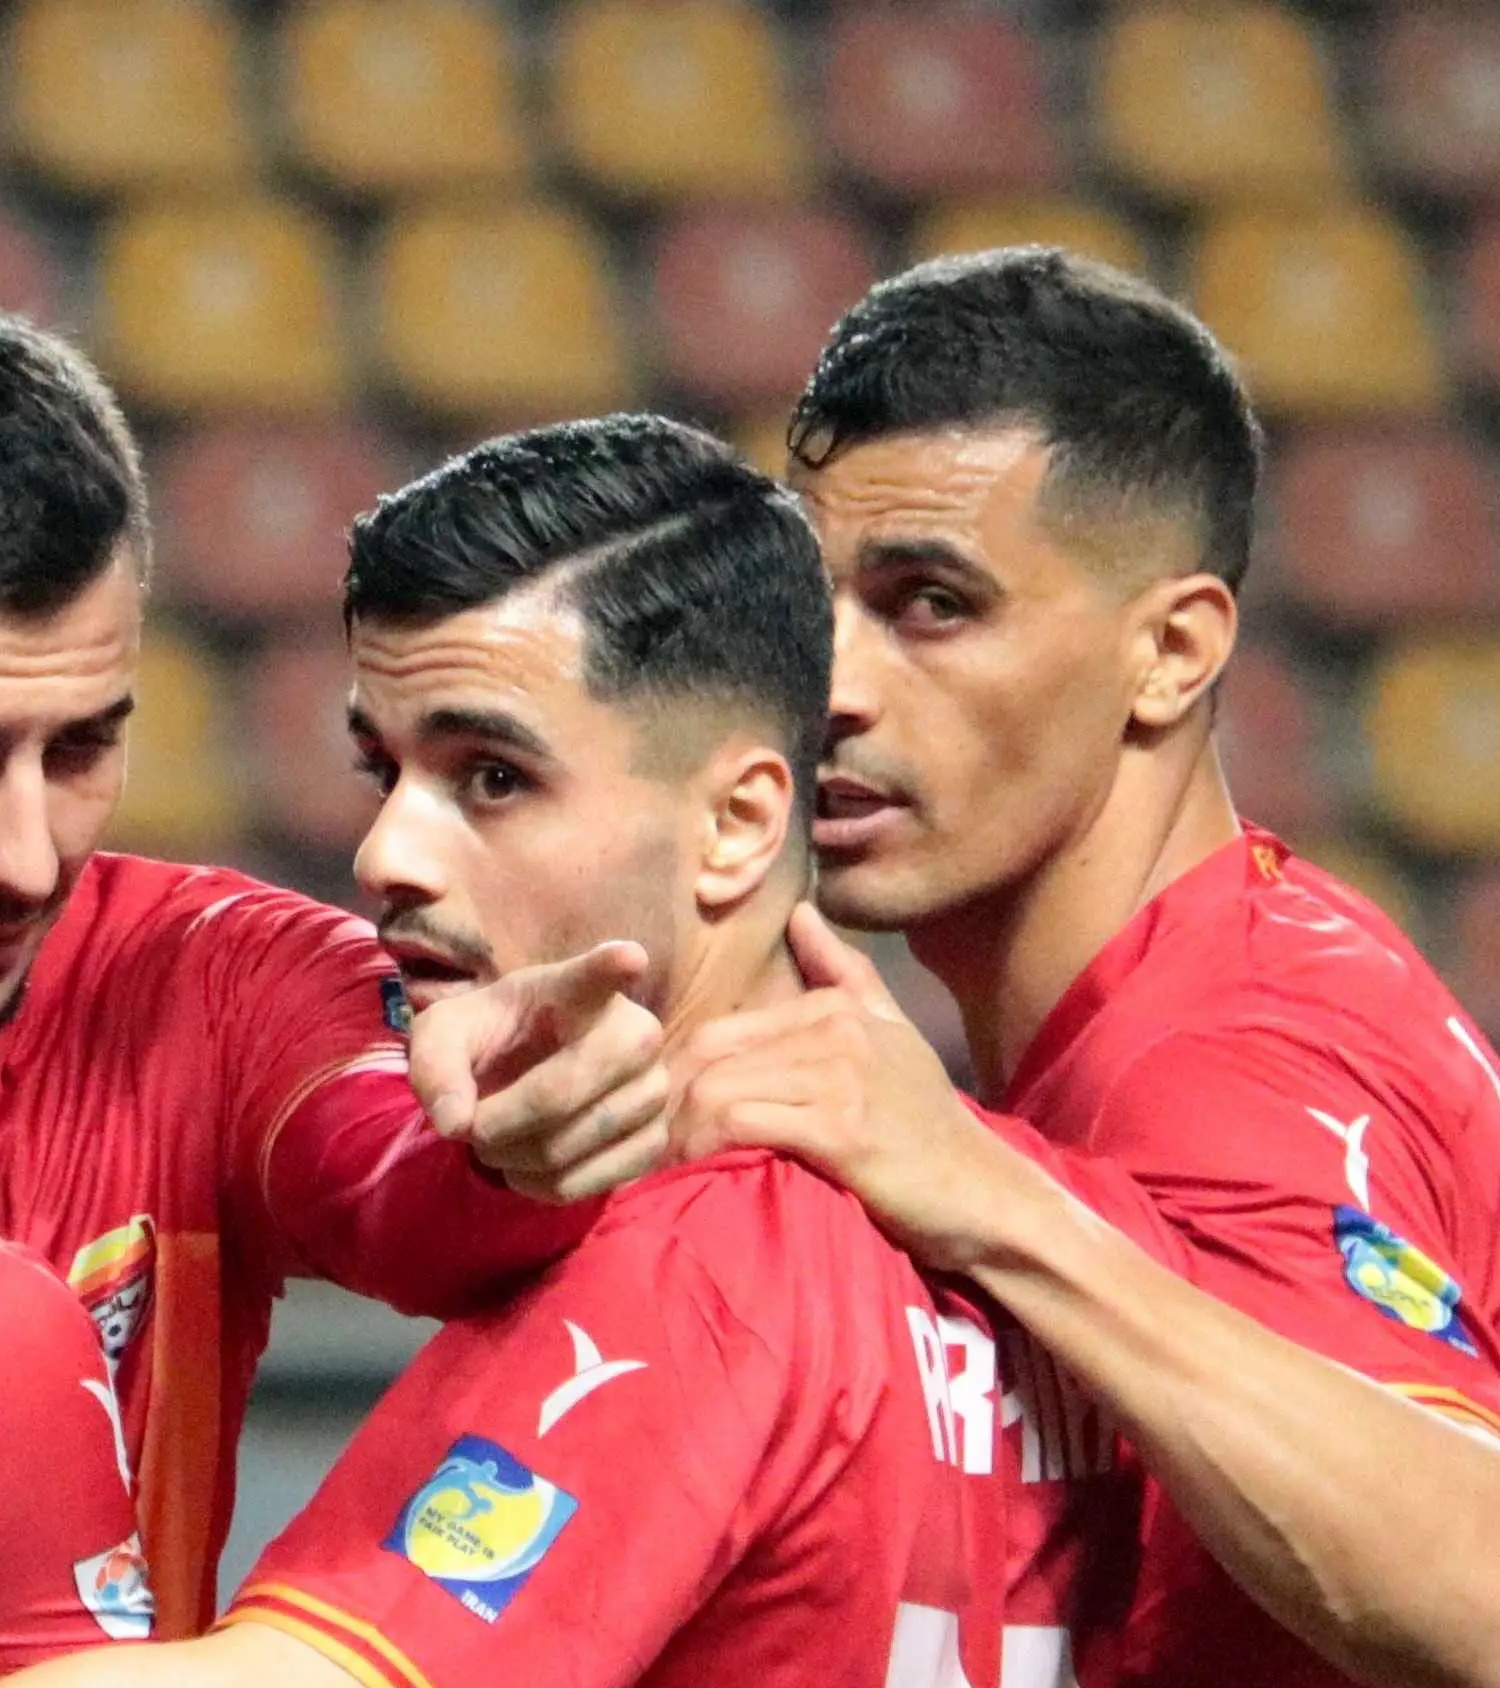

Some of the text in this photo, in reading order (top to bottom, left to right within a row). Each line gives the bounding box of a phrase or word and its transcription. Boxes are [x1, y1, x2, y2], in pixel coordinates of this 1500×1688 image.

[419, 1517, 476, 1557] FAIR PLAY
[426, 1506, 445, 1524] MY
[447, 1520, 481, 1547] GAME
[461, 1590, 499, 1623] IRAN
